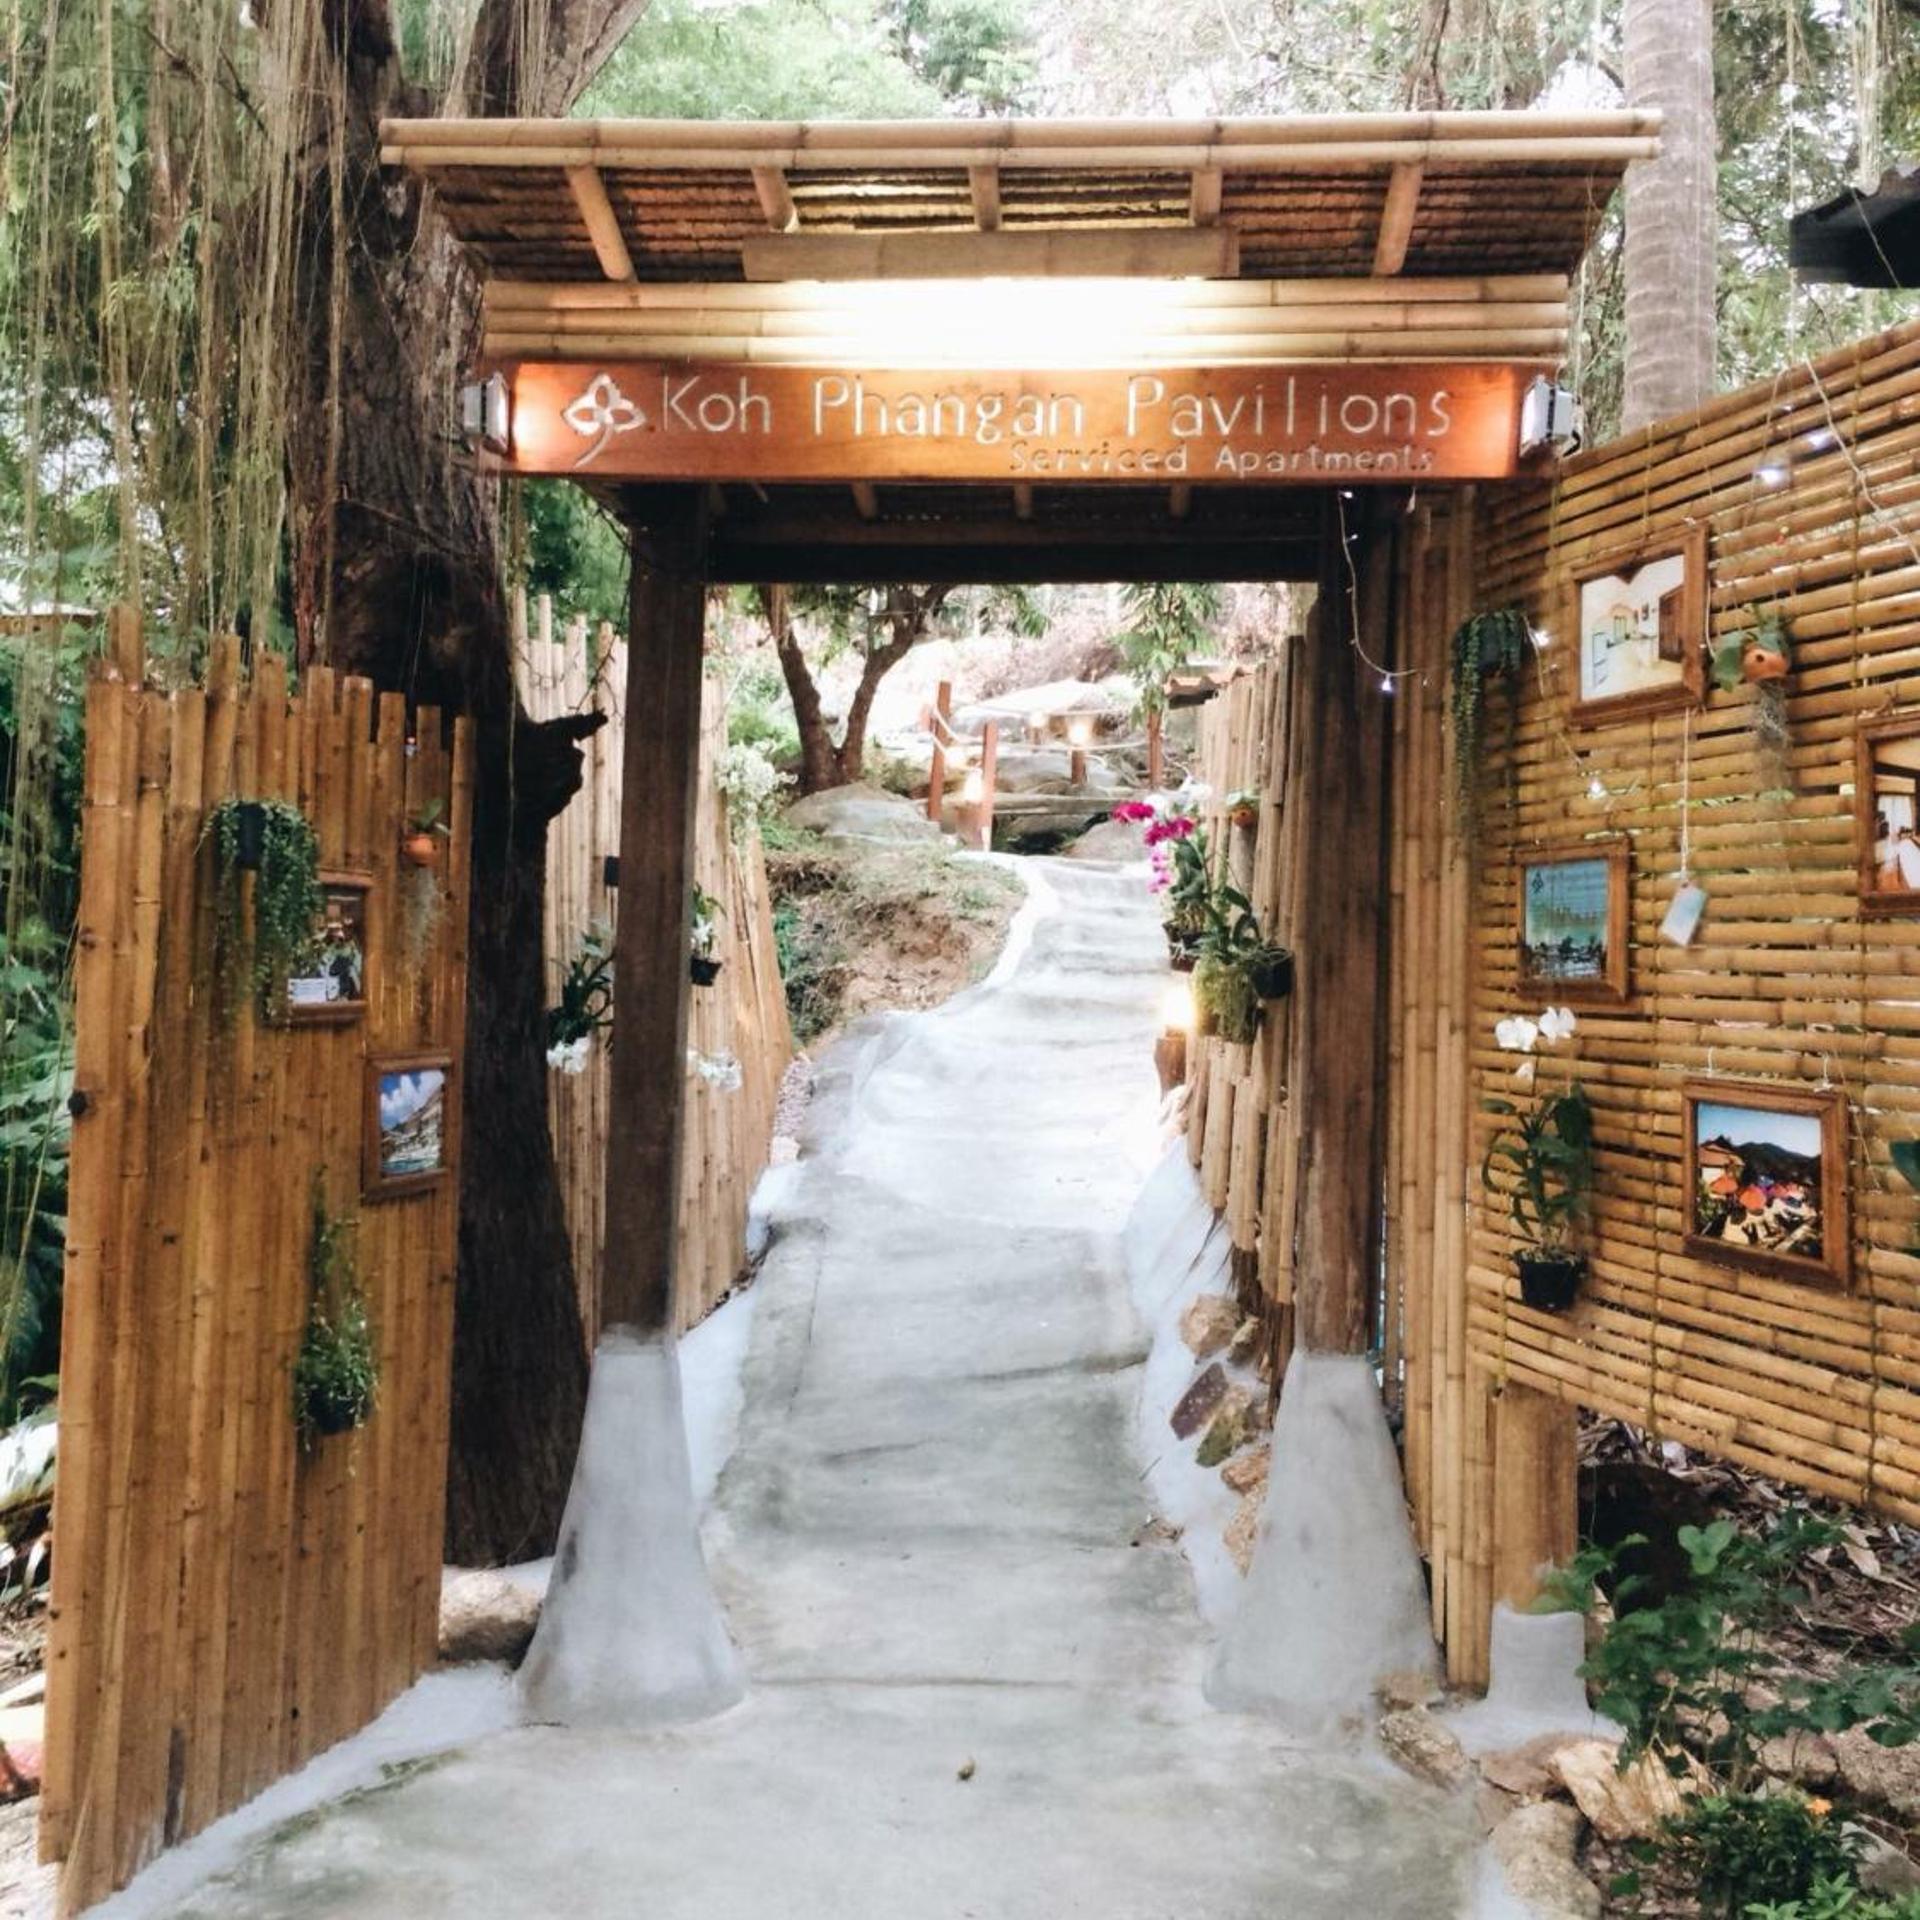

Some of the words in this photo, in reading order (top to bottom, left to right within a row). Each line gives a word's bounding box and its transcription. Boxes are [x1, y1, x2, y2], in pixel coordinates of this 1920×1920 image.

[663, 375, 771, 432] Koh
[813, 375, 1083, 445] Phangan
[1126, 375, 1453, 437] Pavilions
[1009, 441, 1188, 473] Serviced
[1214, 443, 1436, 477] Apartments
